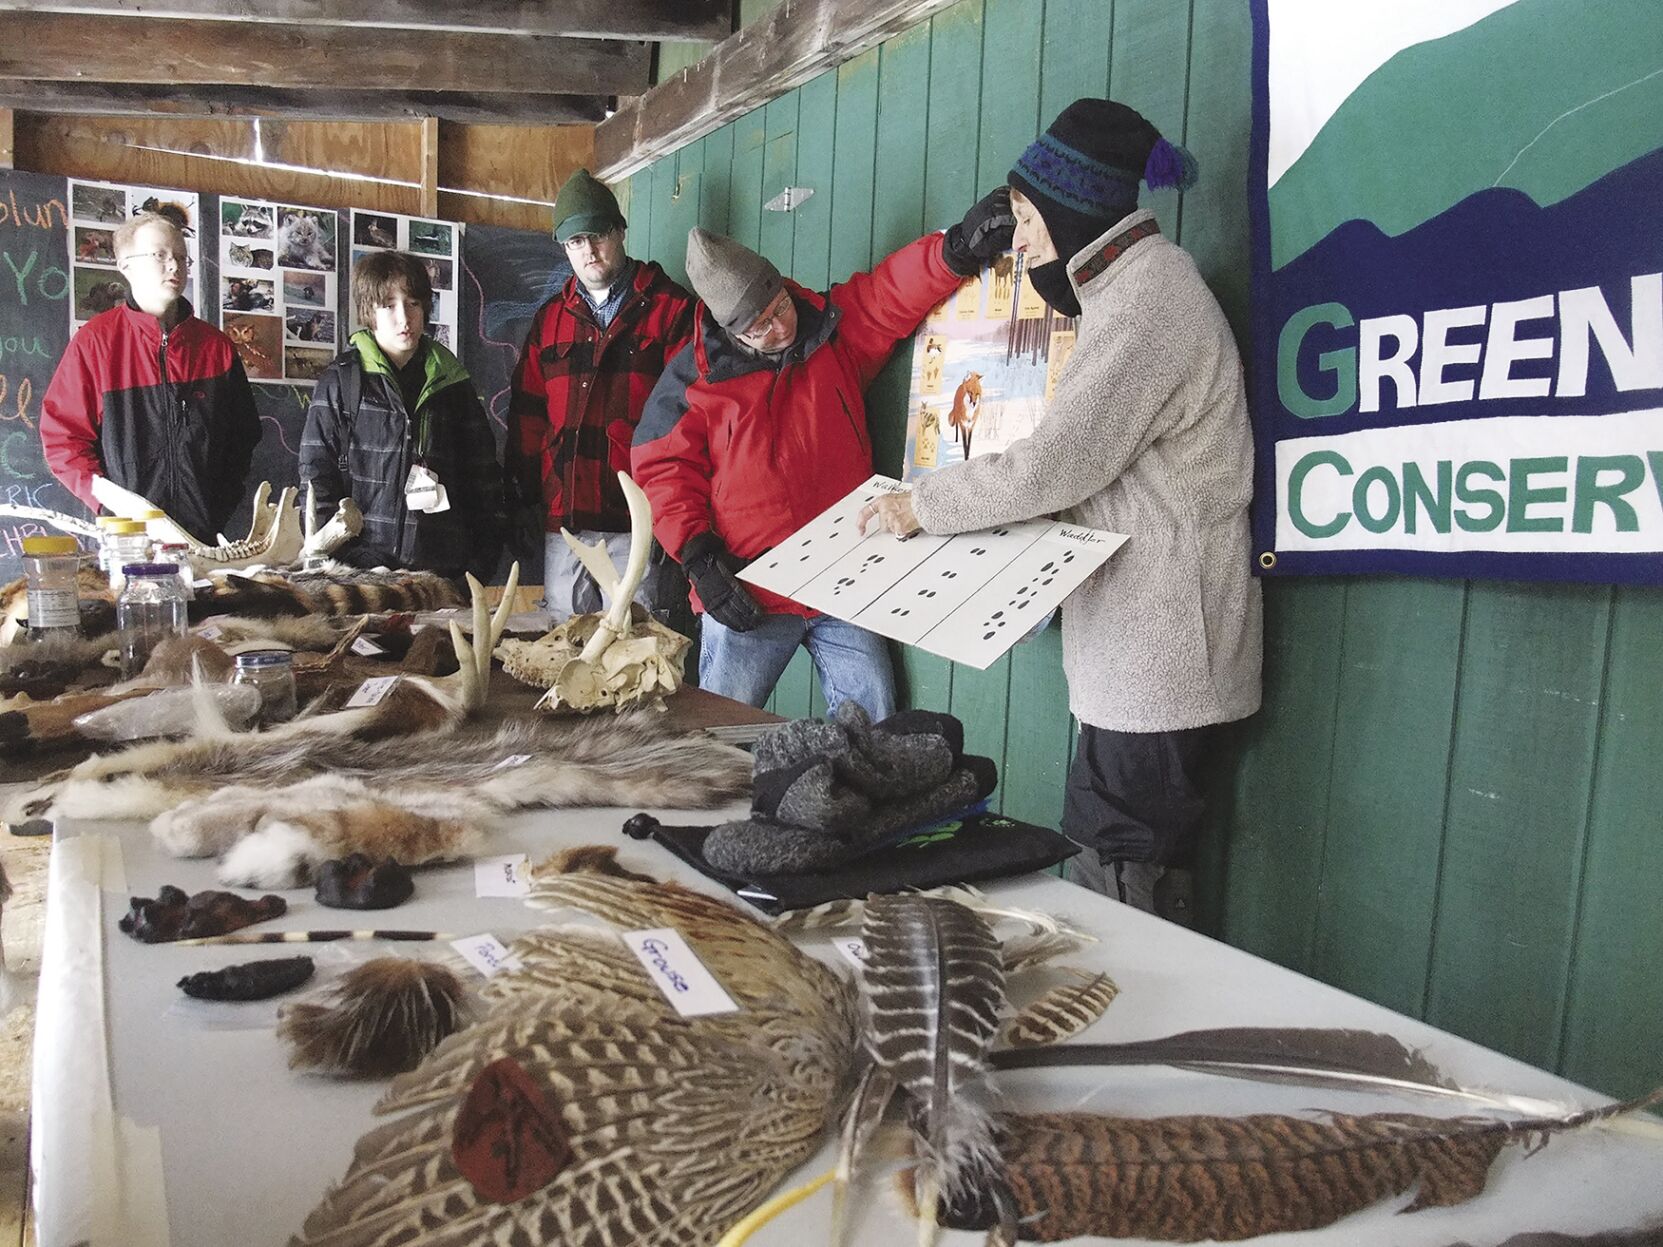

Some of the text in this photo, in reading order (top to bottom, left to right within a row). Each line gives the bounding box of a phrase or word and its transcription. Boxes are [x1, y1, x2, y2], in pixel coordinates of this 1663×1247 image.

[0, 336, 53, 360] ou
[1277, 272, 1663, 420] GREEN
[1288, 450, 1663, 539] CONSER
[642, 938, 689, 993] Grouse
